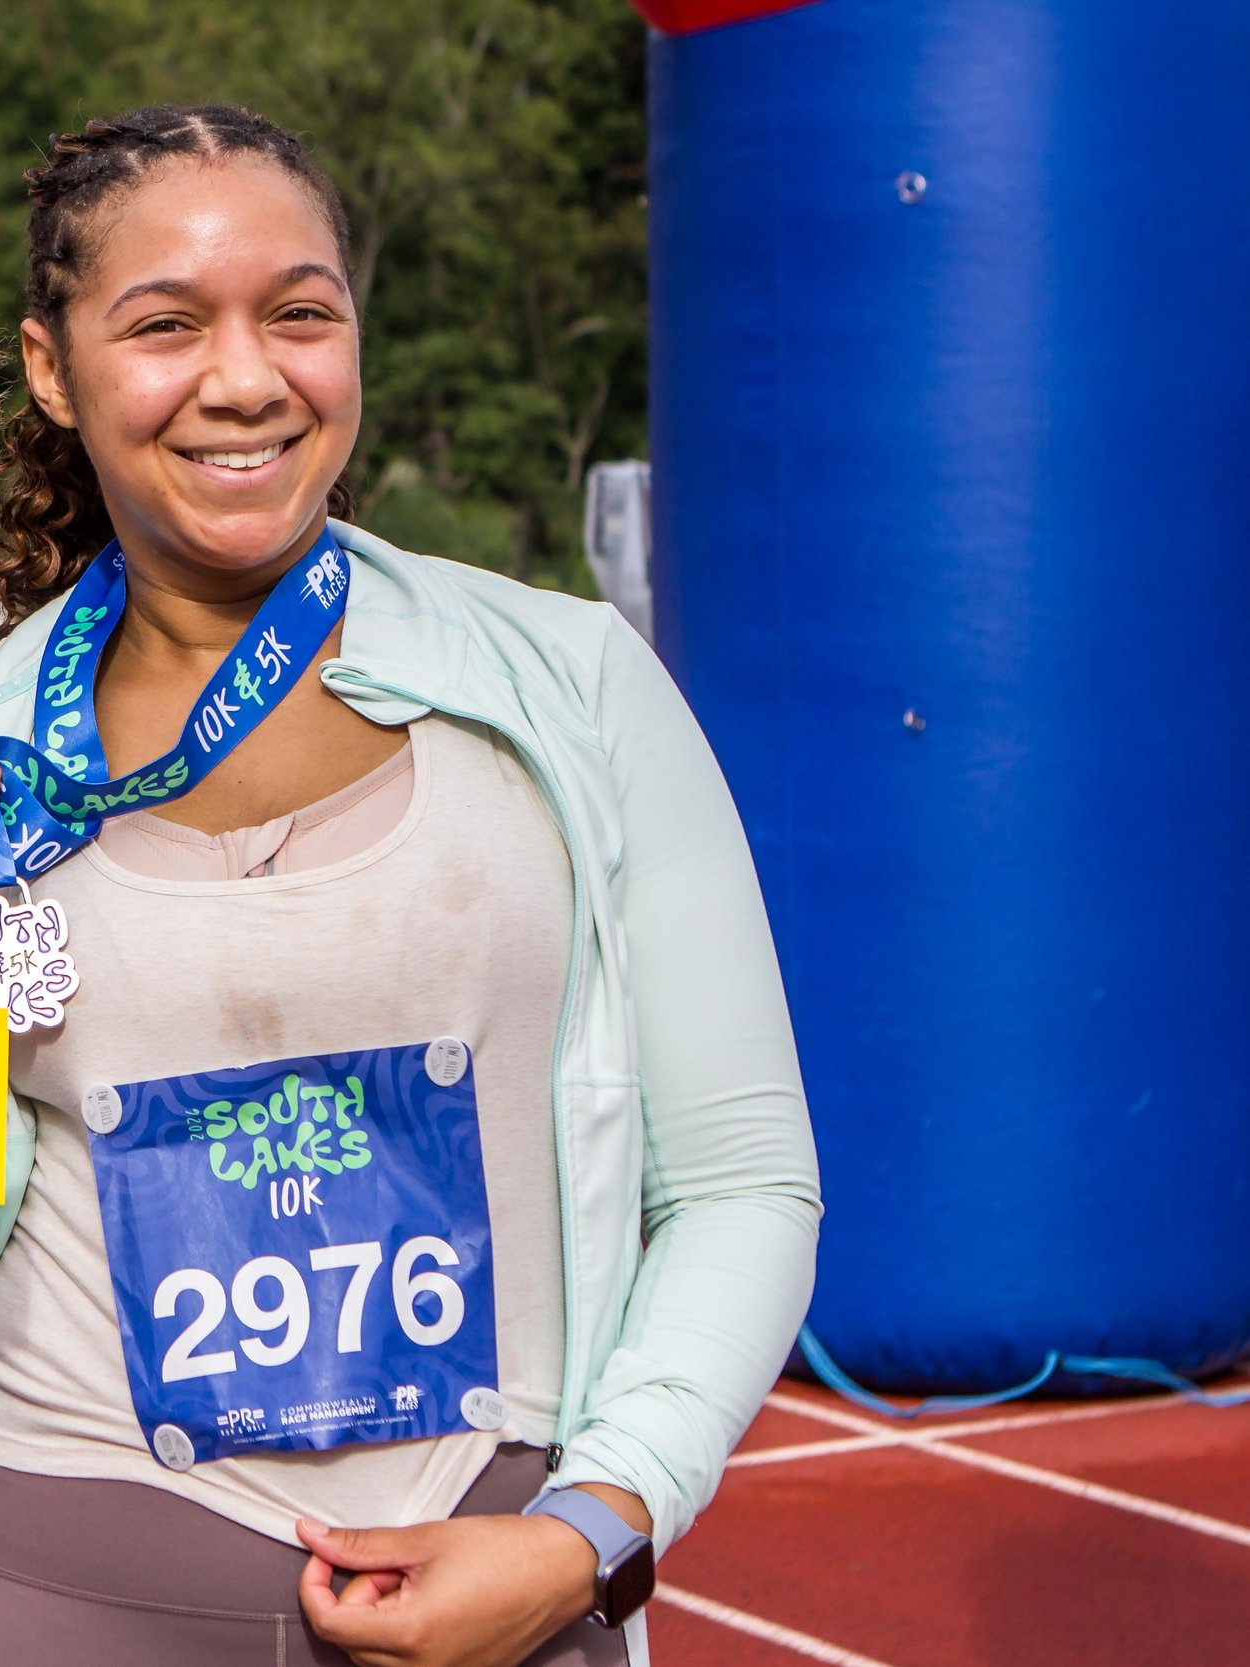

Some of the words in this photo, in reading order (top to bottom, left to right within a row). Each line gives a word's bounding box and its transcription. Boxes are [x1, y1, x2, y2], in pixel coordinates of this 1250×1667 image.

[306, 551, 341, 597] PR
[318, 570, 347, 610] RACES
[44, 606, 107, 706] SOUTH
[194, 692, 241, 753] 10K
[233, 658, 265, 706] &
[254, 625, 292, 686] 5K
[203, 1074, 364, 1139] SOUTH
[206, 1122, 373, 1189] LAKES
[270, 1175, 324, 1220] 10K
[153, 1235, 465, 1383] 2976
[280, 1396, 376, 1417] COMMONWEALTH
[281, 1412, 309, 1426] RACE
[309, 1405, 376, 1421] MANAGEMENT
[396, 1400, 419, 1411] RACES
